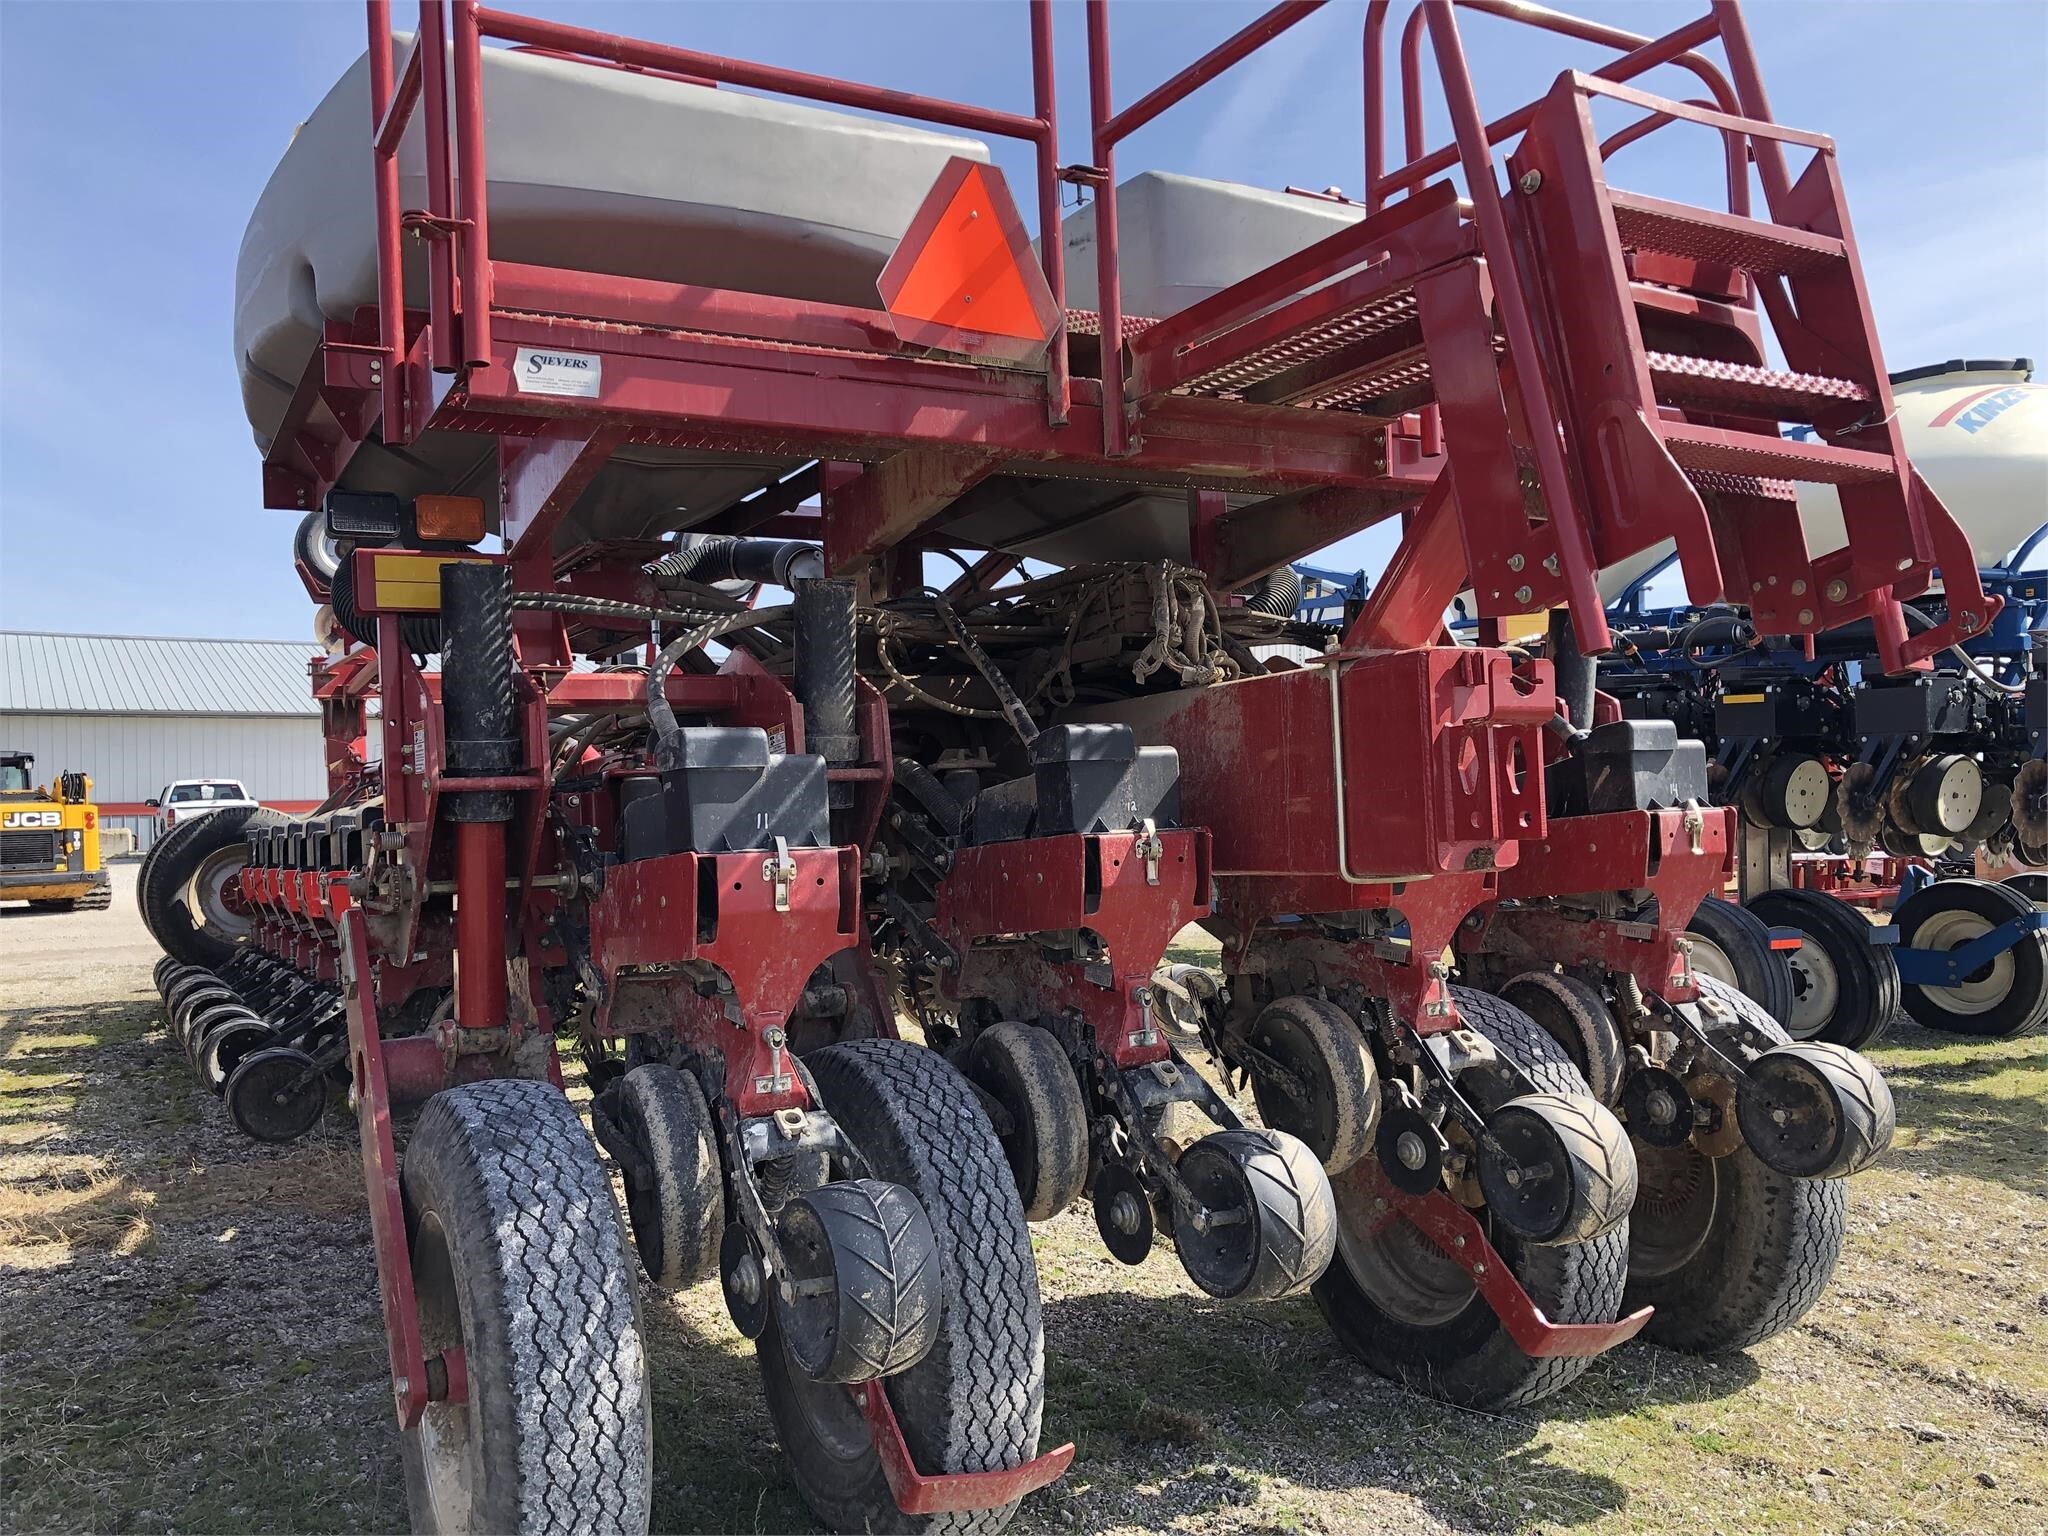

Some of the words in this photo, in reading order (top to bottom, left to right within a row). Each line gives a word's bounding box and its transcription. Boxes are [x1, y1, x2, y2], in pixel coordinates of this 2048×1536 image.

[527, 355, 588, 374] SIEVERS
[1955, 388, 2031, 434] KINZE
[1670, 782, 1679, 798] 14
[1127, 801, 1137, 811] 12
[4, 812, 61, 828] JCB
[757, 812, 768, 829] 11
